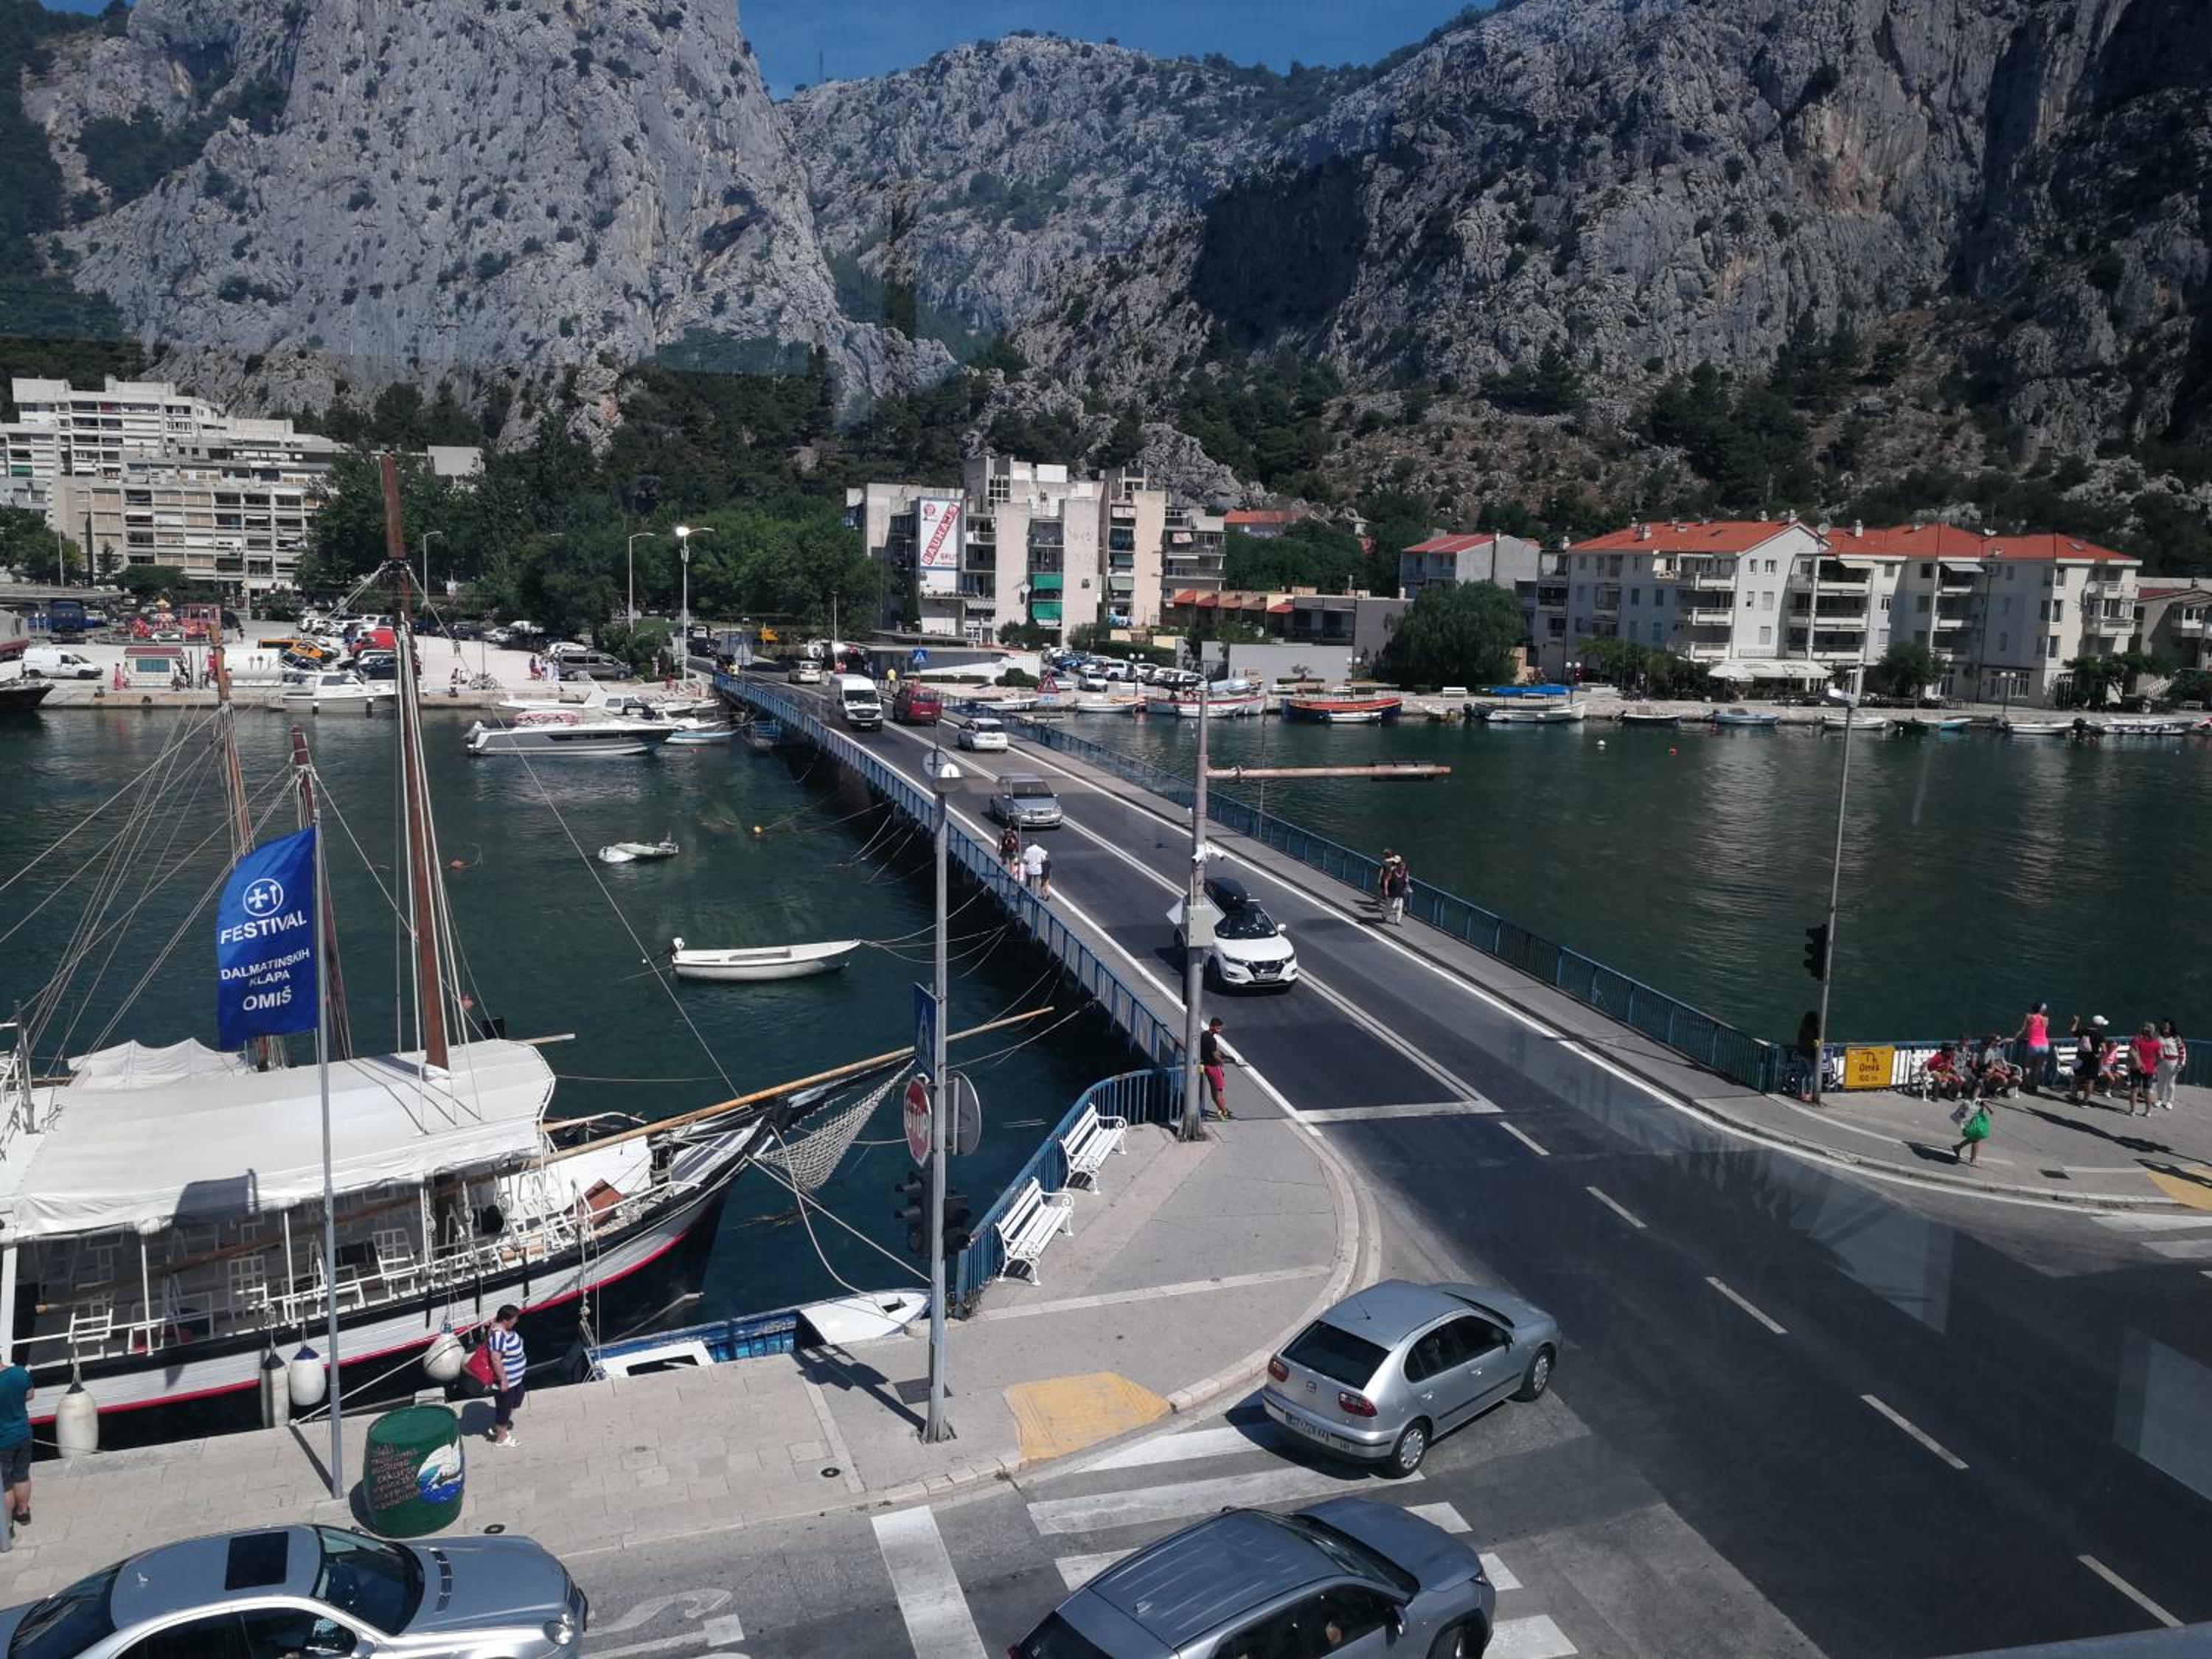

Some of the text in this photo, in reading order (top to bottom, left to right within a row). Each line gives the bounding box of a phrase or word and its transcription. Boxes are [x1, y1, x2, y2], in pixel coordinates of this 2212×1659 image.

[923, 504, 958, 564] BAUHAUS
[220, 911, 307, 945] FESTIVAL
[221, 948, 310, 980] DALMATINSKIH
[249, 970, 291, 988] KLAPA
[243, 986, 292, 1011] OMIŠ
[906, 1097, 930, 1140] STOP
